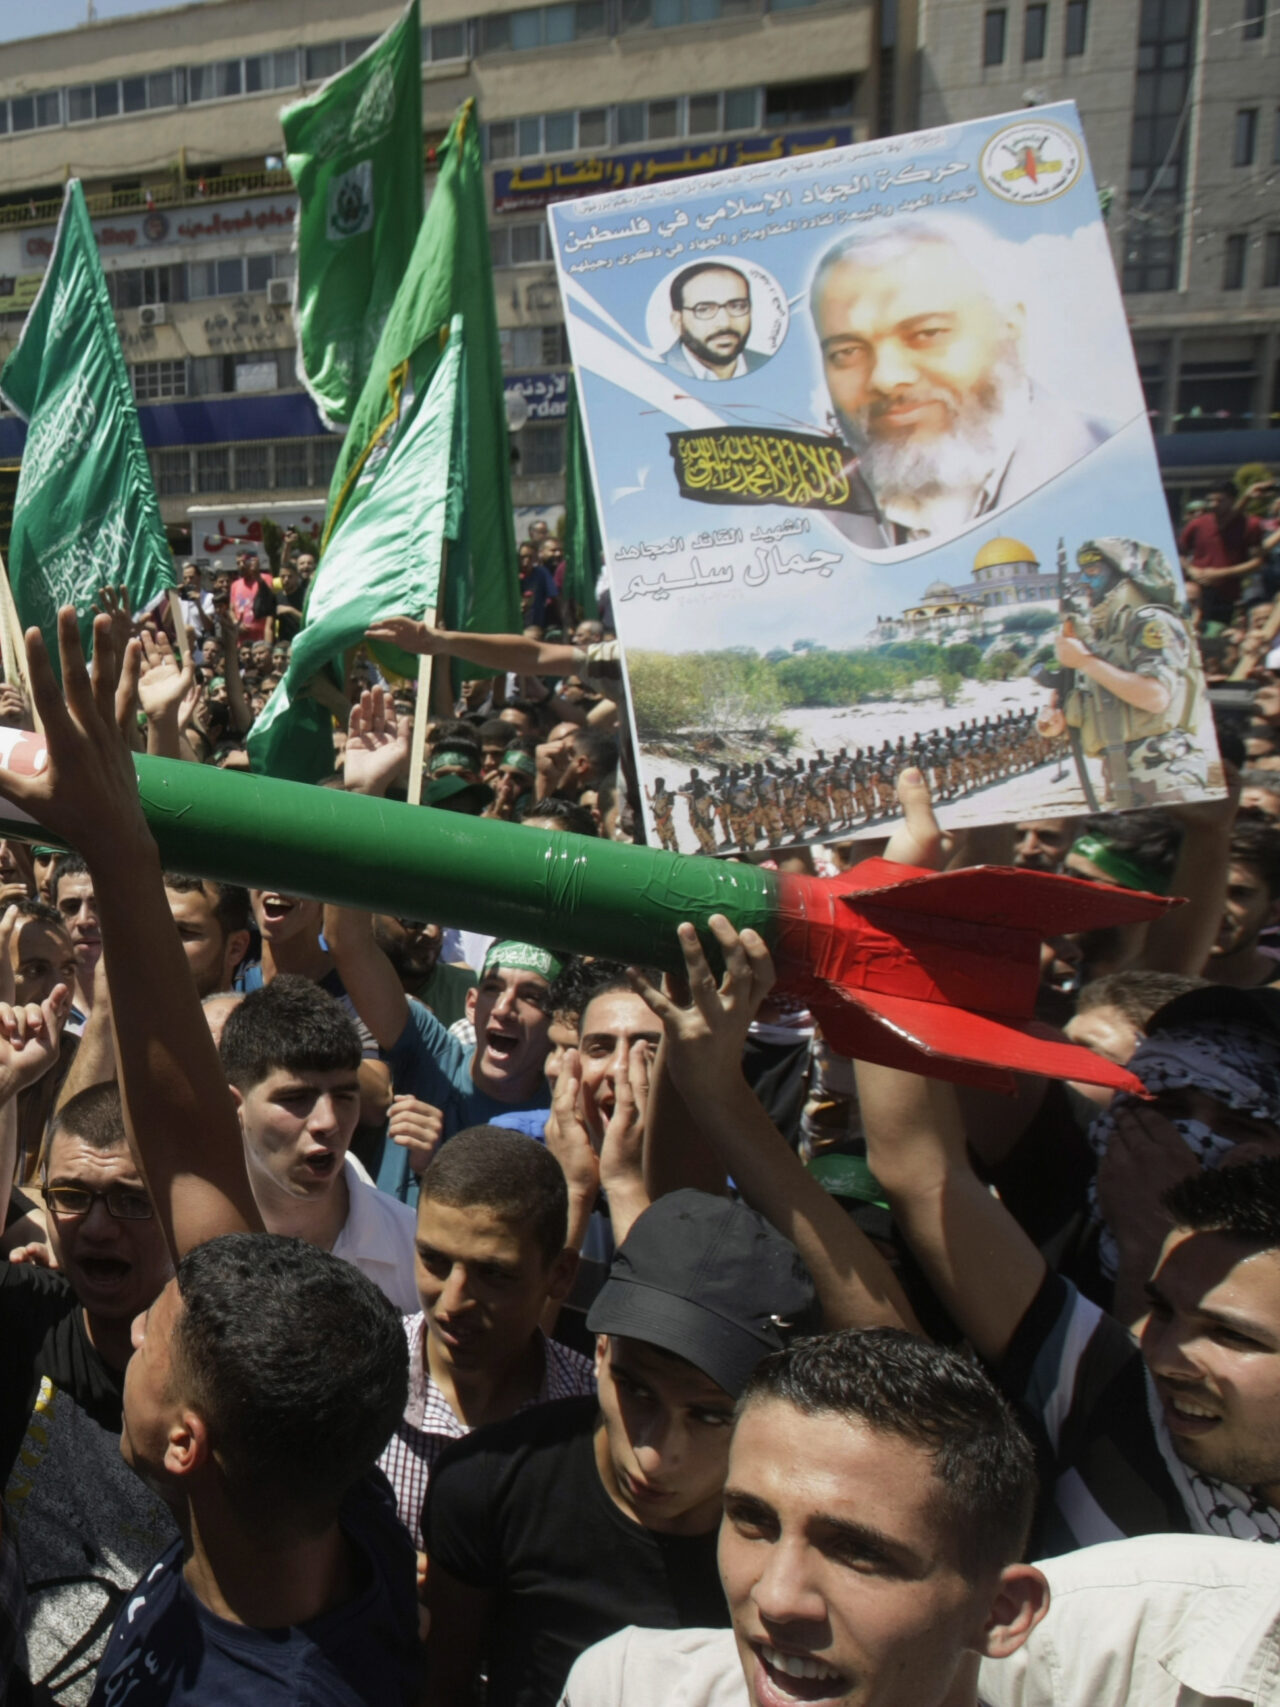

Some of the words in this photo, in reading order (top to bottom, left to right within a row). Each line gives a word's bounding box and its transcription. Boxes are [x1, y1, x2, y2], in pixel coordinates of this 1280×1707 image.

[801, 174, 870, 205] الجهاد
[875, 160, 969, 192] حركة
[657, 208, 690, 238] في
[696, 187, 792, 232] الإسلامي
[564, 214, 651, 253] فلسطين
[691, 527, 743, 550] القائد
[750, 517, 810, 544] الشهيد
[614, 536, 684, 561] المجاهد
[619, 555, 734, 601] سليم
[743, 546, 843, 587] جمال
